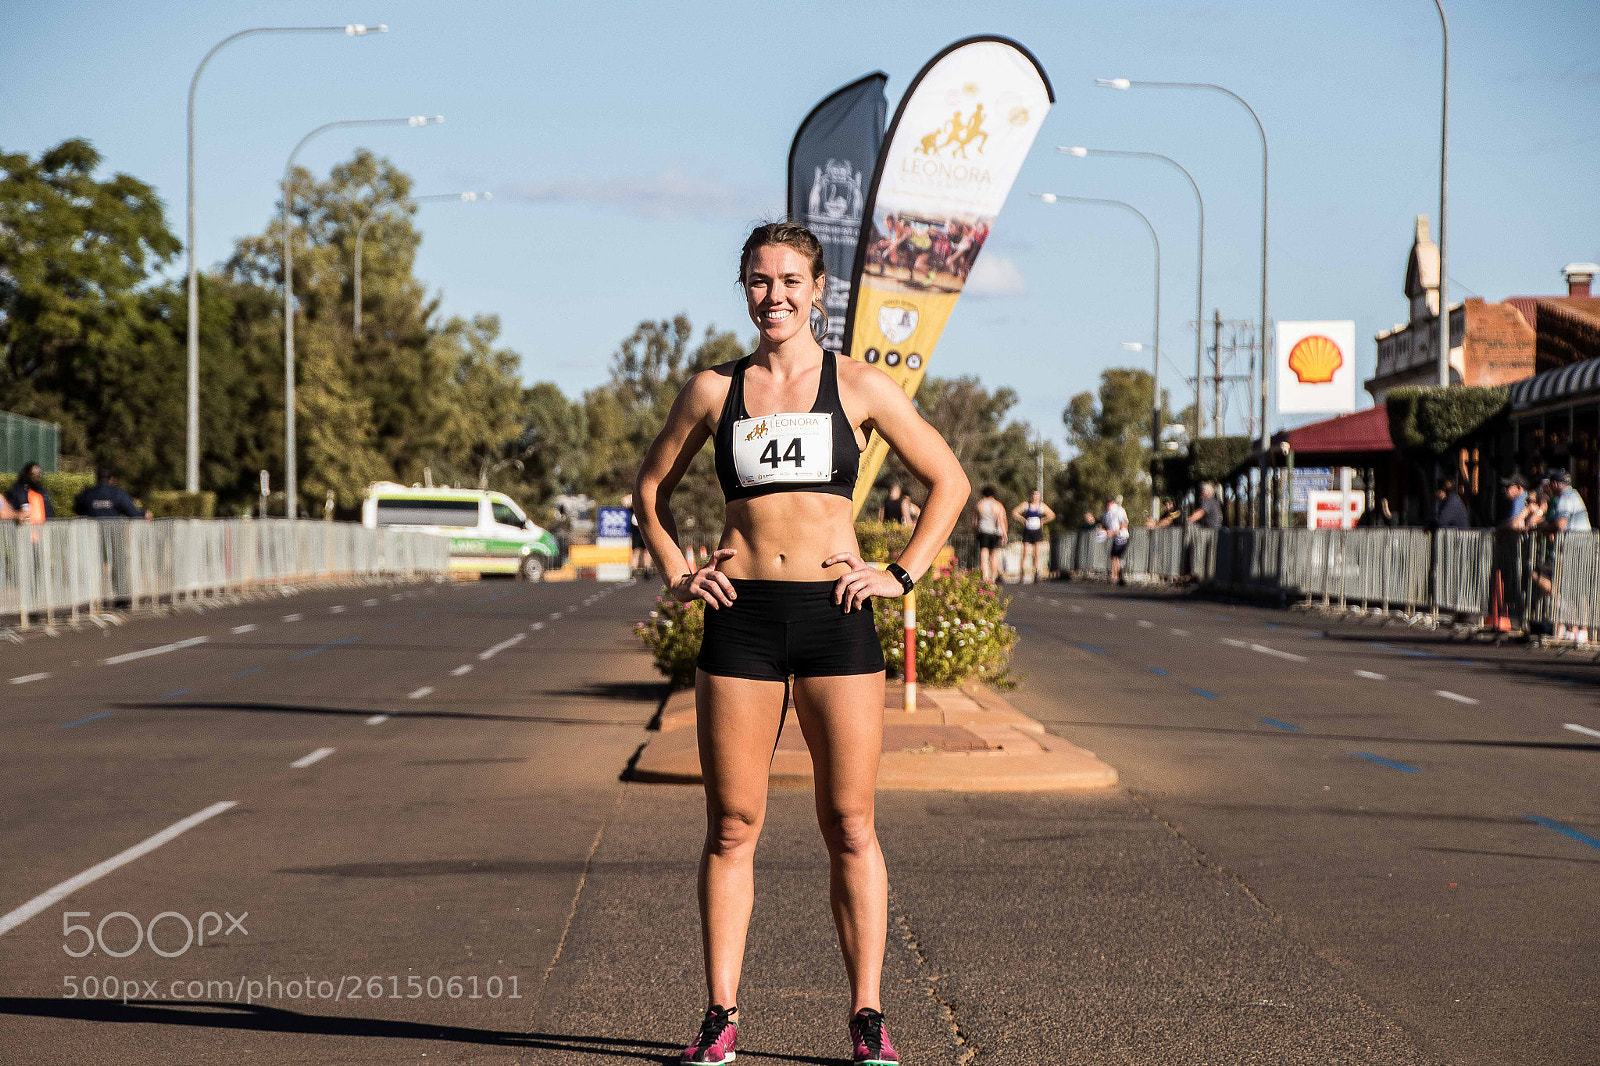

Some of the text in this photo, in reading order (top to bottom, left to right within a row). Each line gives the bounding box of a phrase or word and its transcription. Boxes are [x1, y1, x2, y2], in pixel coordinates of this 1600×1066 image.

[901, 157, 992, 185] LEONORA
[770, 418, 819, 429] LEONORA
[759, 437, 806, 469] 44
